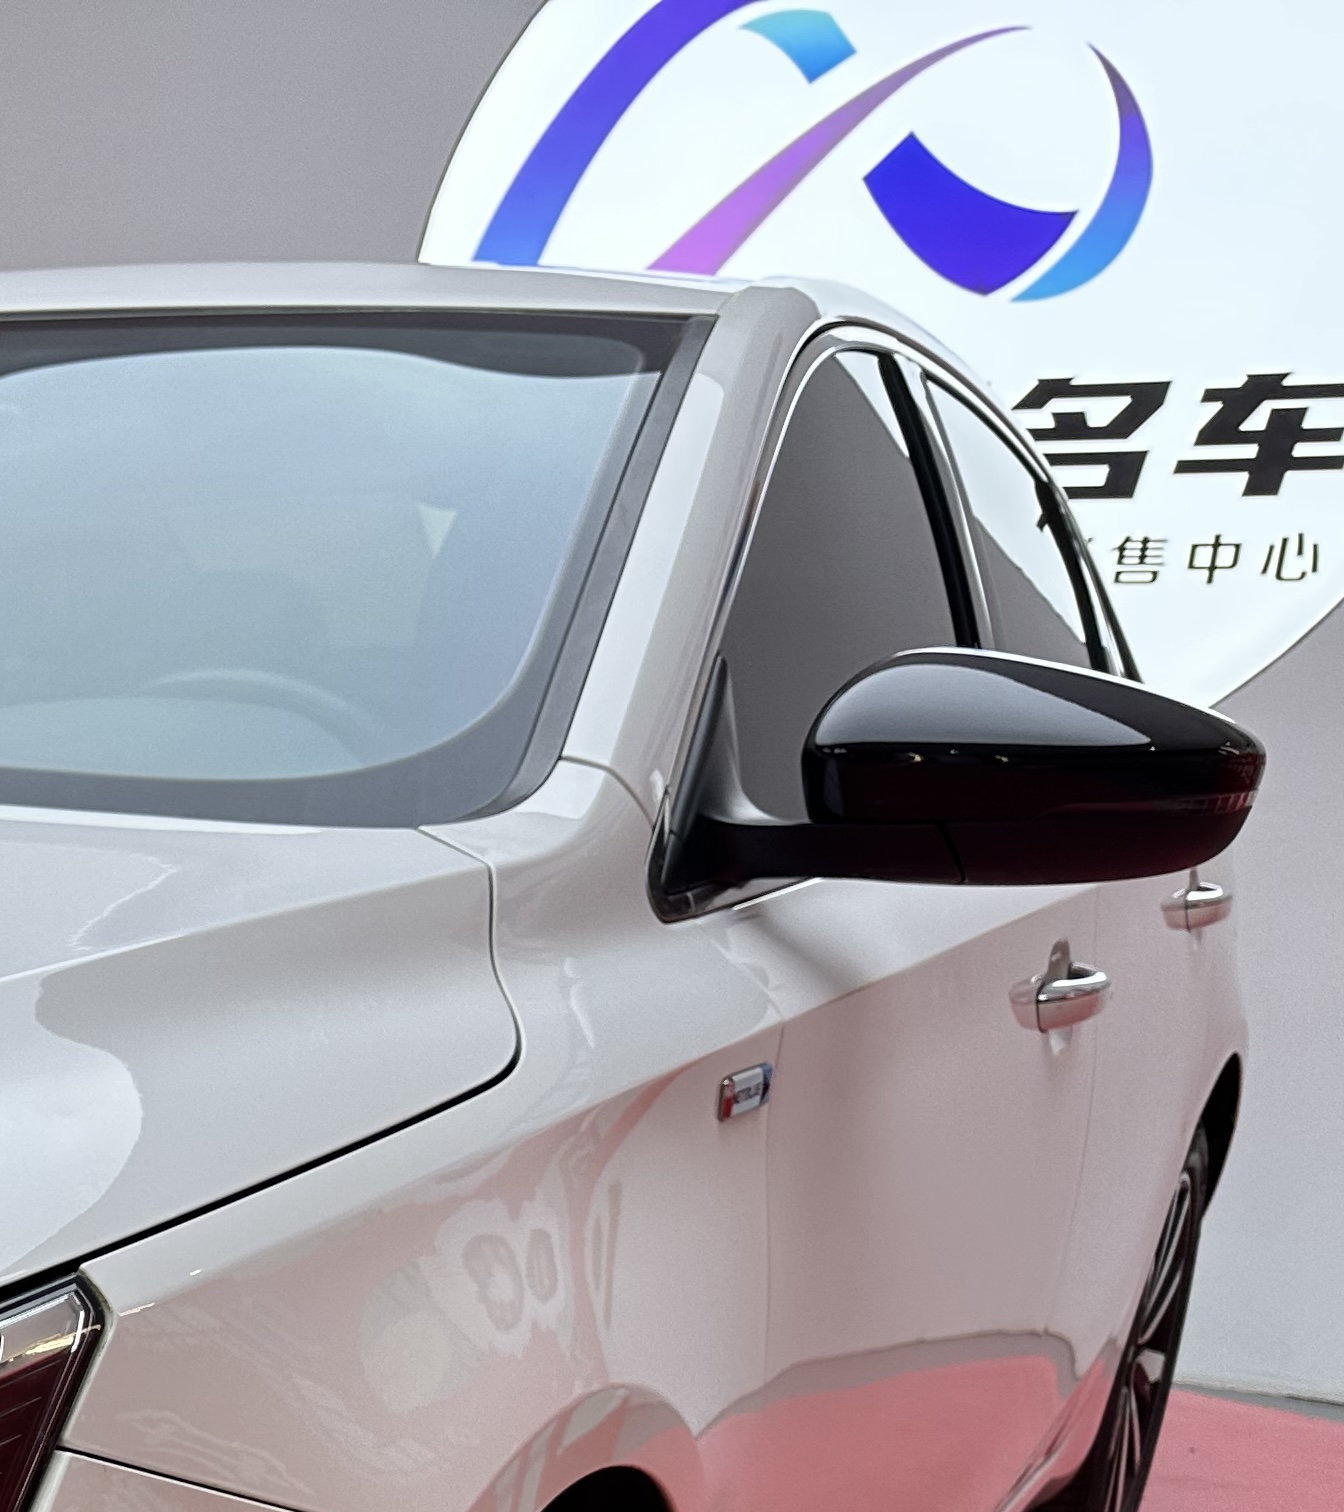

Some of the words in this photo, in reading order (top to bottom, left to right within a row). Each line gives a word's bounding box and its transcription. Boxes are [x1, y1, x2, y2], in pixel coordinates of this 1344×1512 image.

[1012, 371, 1344, 500] 名车
[1086, 532, 1320, 585] 售中心
